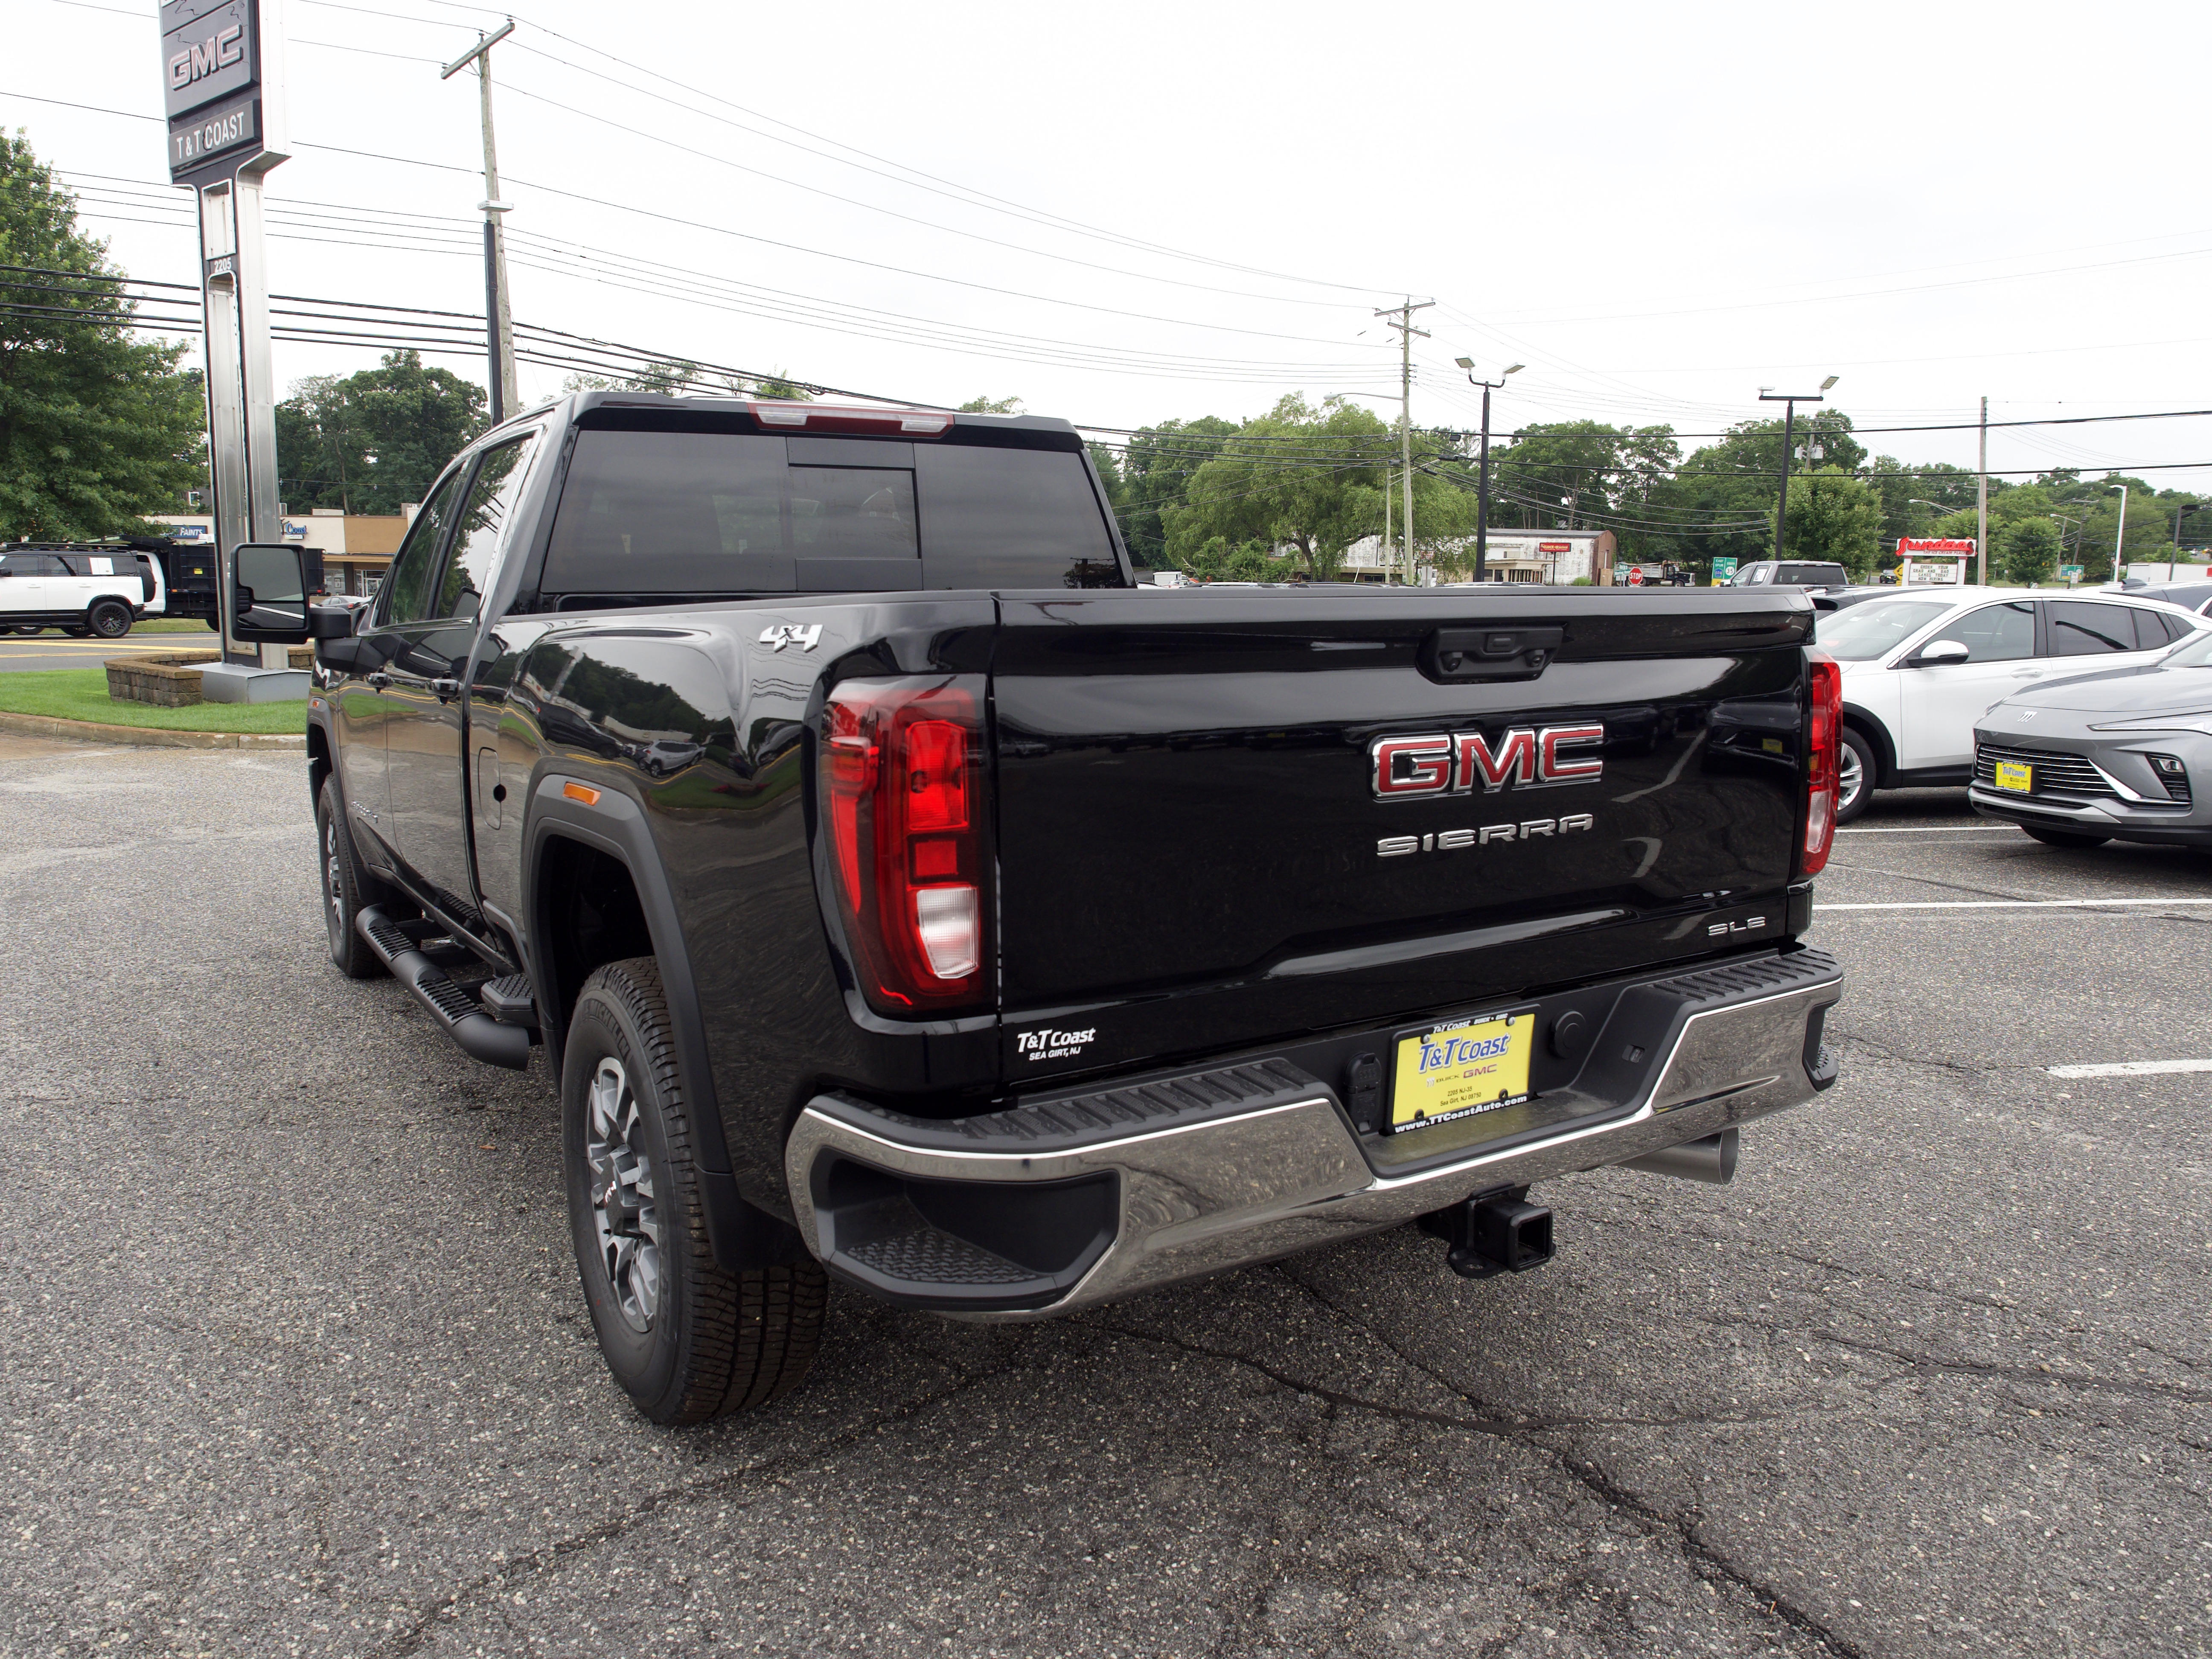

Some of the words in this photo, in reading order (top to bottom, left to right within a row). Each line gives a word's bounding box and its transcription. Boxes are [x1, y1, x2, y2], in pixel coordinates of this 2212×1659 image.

[169, 24, 243, 90] GMC
[205, 111, 244, 151] COAST
[214, 257, 232, 273] 2205
[285, 523, 307, 534] Coast
[1371, 723, 1604, 797] GMC
[1377, 814, 1593, 857] SIERRA
[1708, 917, 1766, 936] SLE
[1017, 1029, 1053, 1053] T&T
[1050, 1027, 1096, 1047] Coast
[1432, 1024, 1448, 1034] T&T
[1447, 1020, 1471, 1031] Coast
[1029, 1051, 1046, 1061] SEA
[1048, 1048, 1069, 1058] GIRT,
[1069, 1046, 1081, 1055] NJ
[1419, 1036, 1461, 1073] T&T
[1456, 1033, 1511, 1064] Coast
[1436, 1074, 1460, 1083] BUICK
[1463, 1064, 1497, 1079] GMC
[1395, 1095, 1527, 1133] www.TTCoastAuto.com
